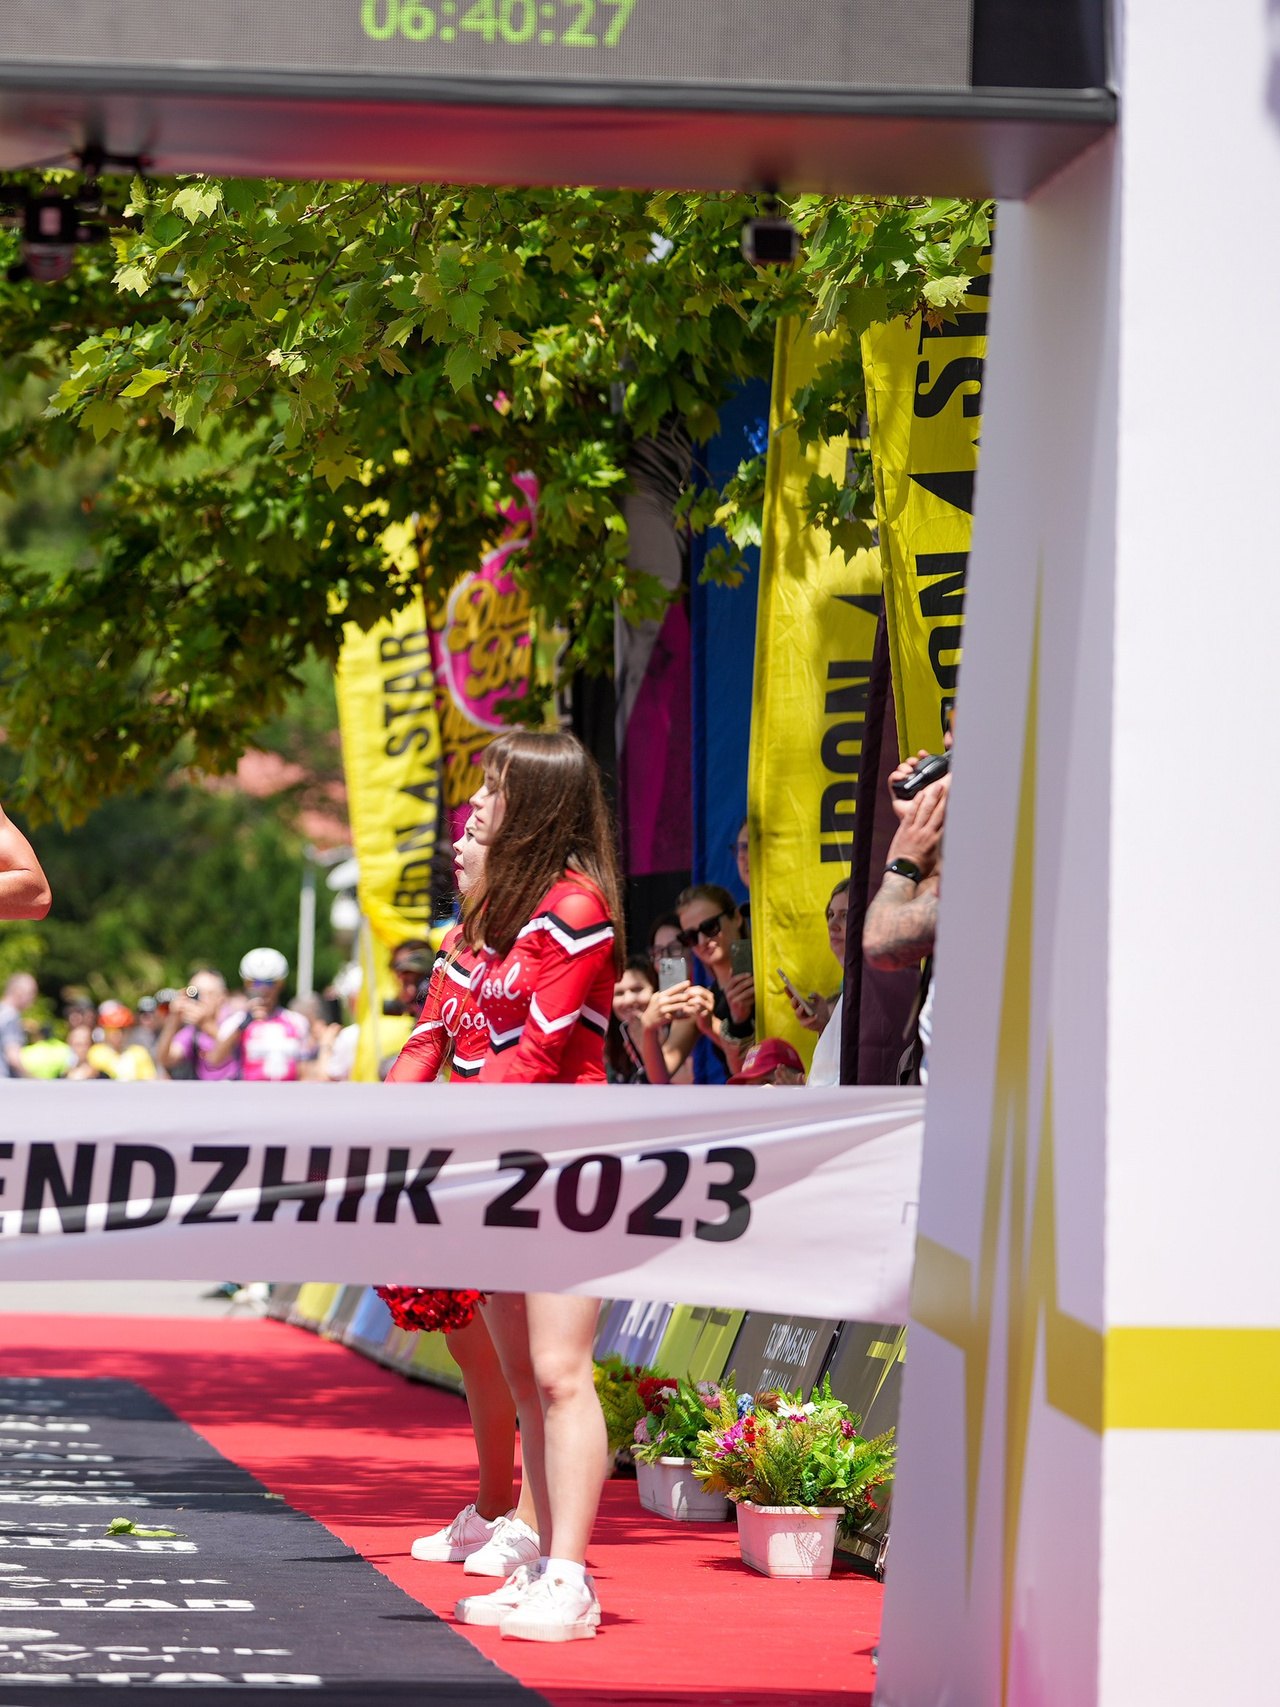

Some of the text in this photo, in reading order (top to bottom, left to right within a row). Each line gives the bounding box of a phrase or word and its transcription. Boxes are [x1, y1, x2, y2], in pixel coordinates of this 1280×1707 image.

[360, 0, 636, 47] 06:40:27
[381, 631, 435, 758] STAR
[441, 997, 488, 1037] Coo
[482, 1145, 758, 1243] 2023
